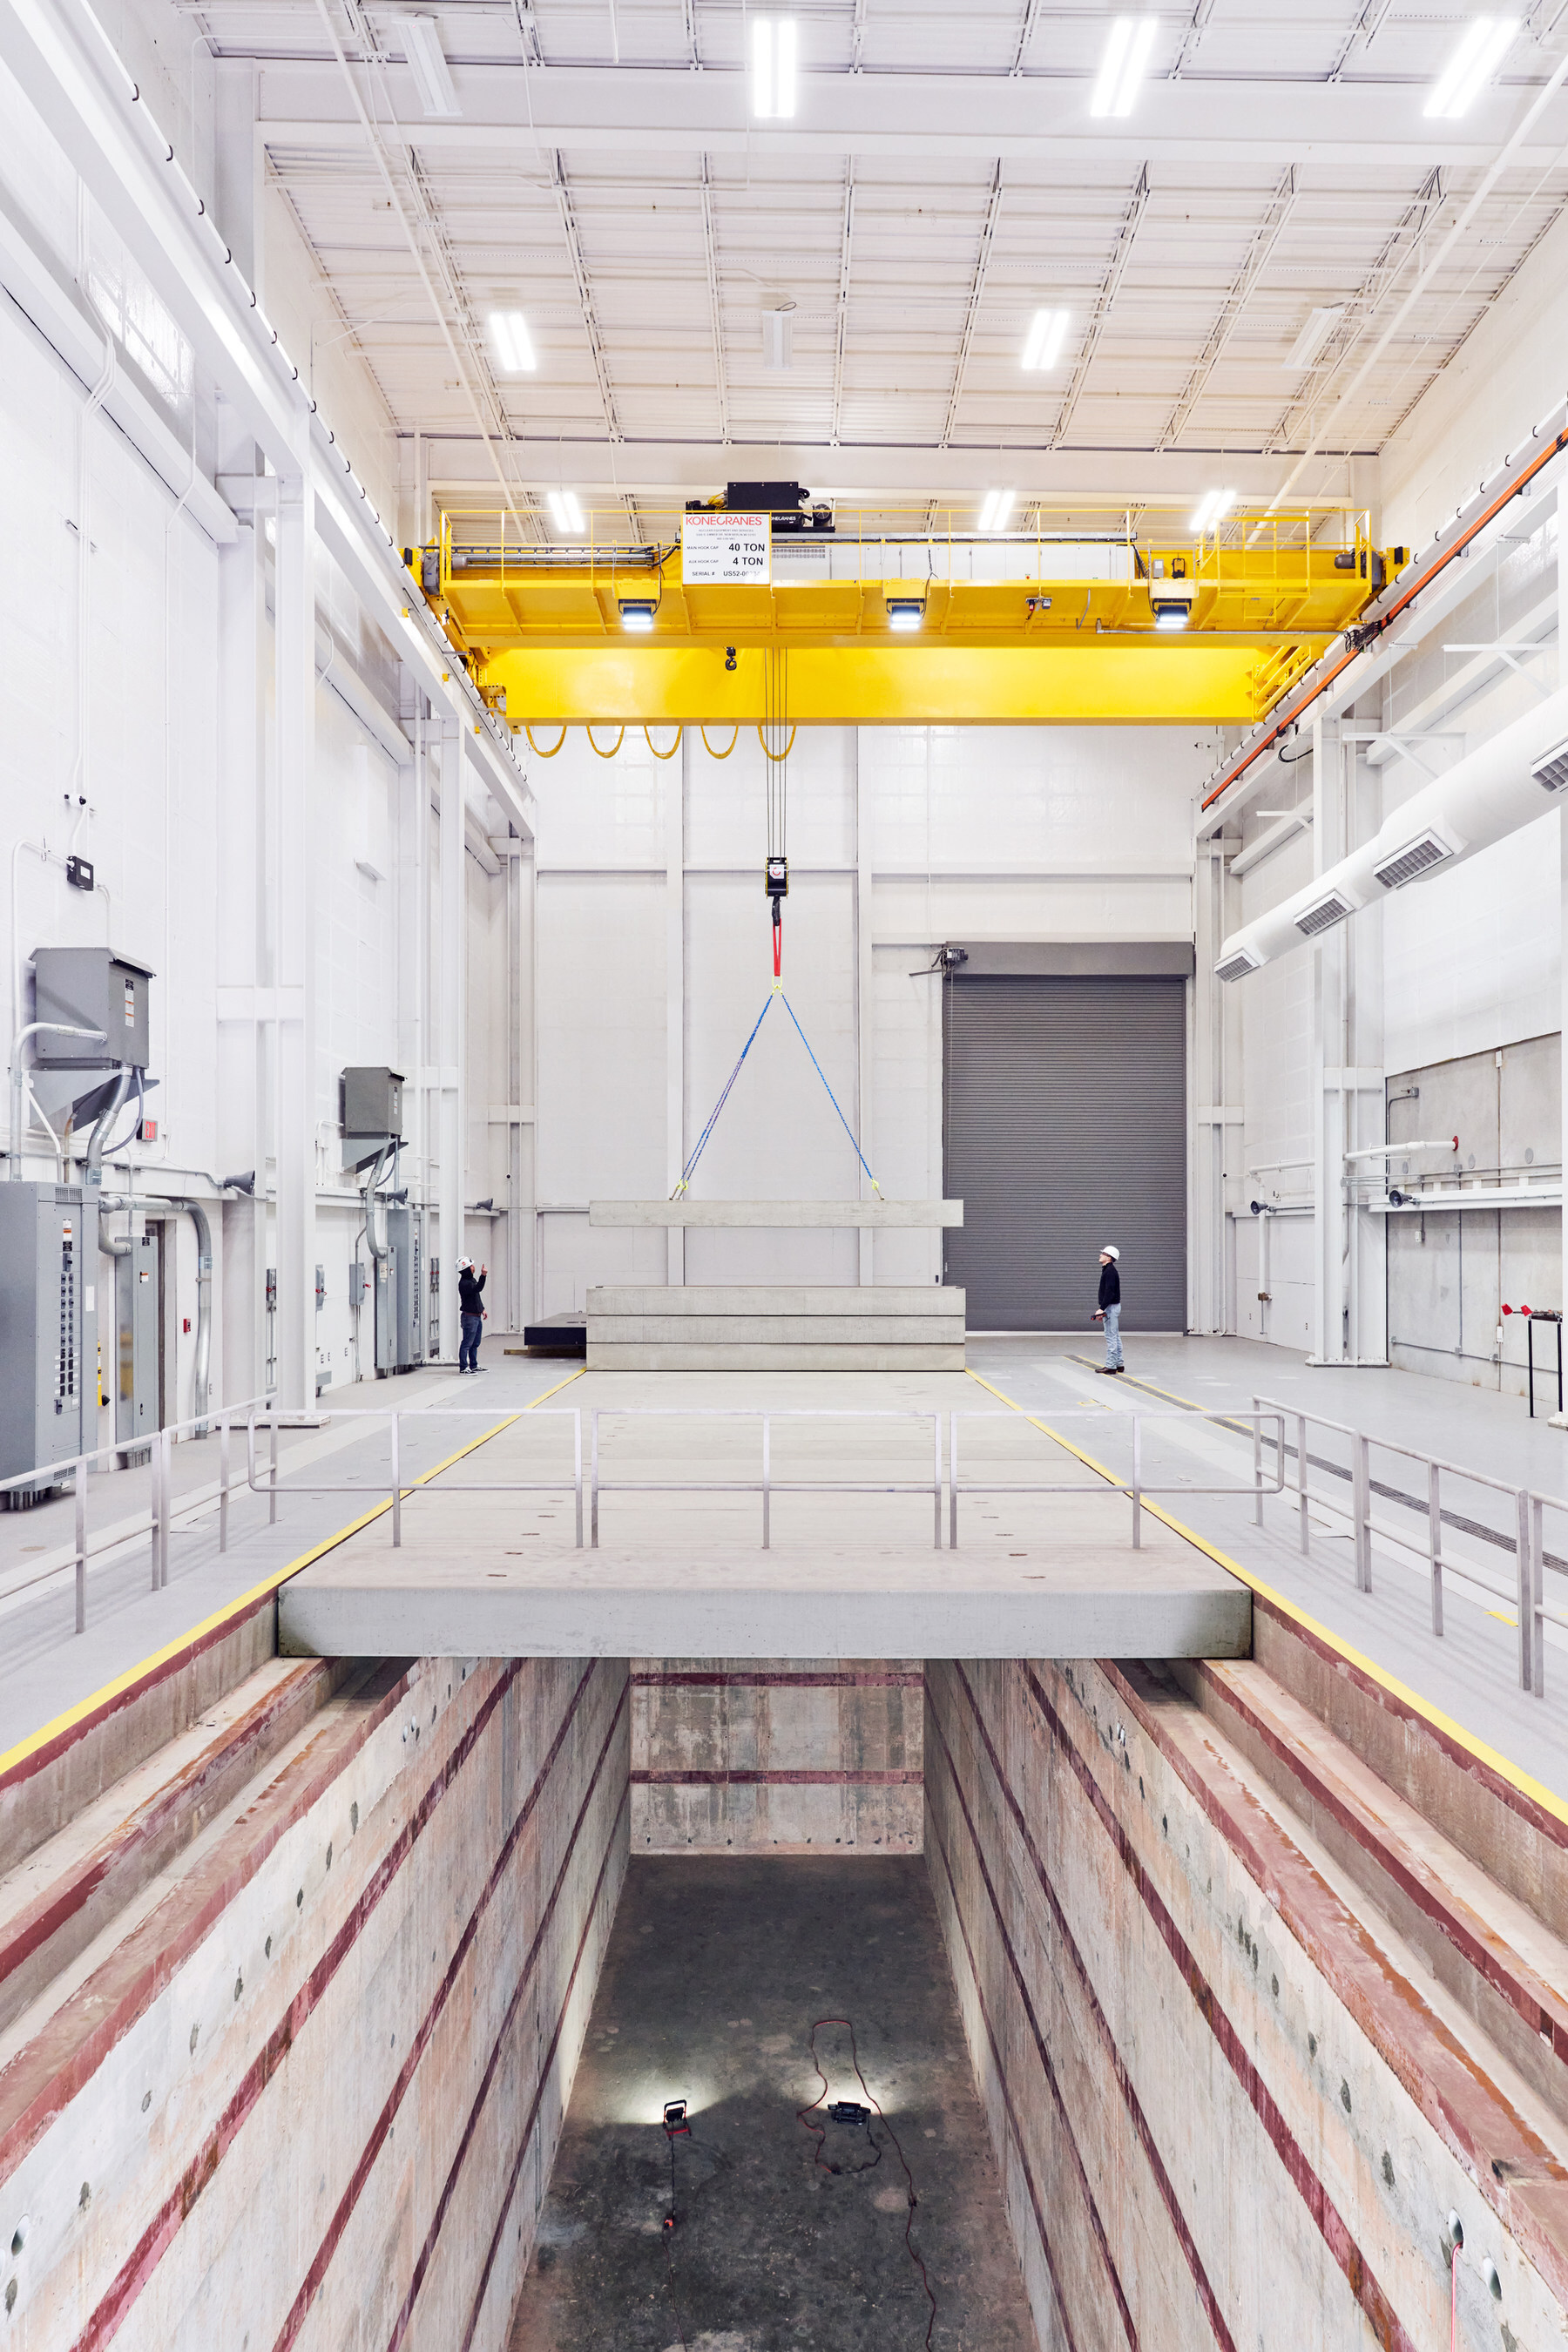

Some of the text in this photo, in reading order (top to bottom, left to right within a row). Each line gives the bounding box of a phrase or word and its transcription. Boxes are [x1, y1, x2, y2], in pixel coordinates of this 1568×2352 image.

[686, 516, 762, 525] KONECRANES
[728, 543, 740, 551] 40
[743, 543, 766, 551] TON
[733, 557, 739, 565] 4
[741, 557, 763, 565] TON
[145, 1121, 156, 1139] EXIT
